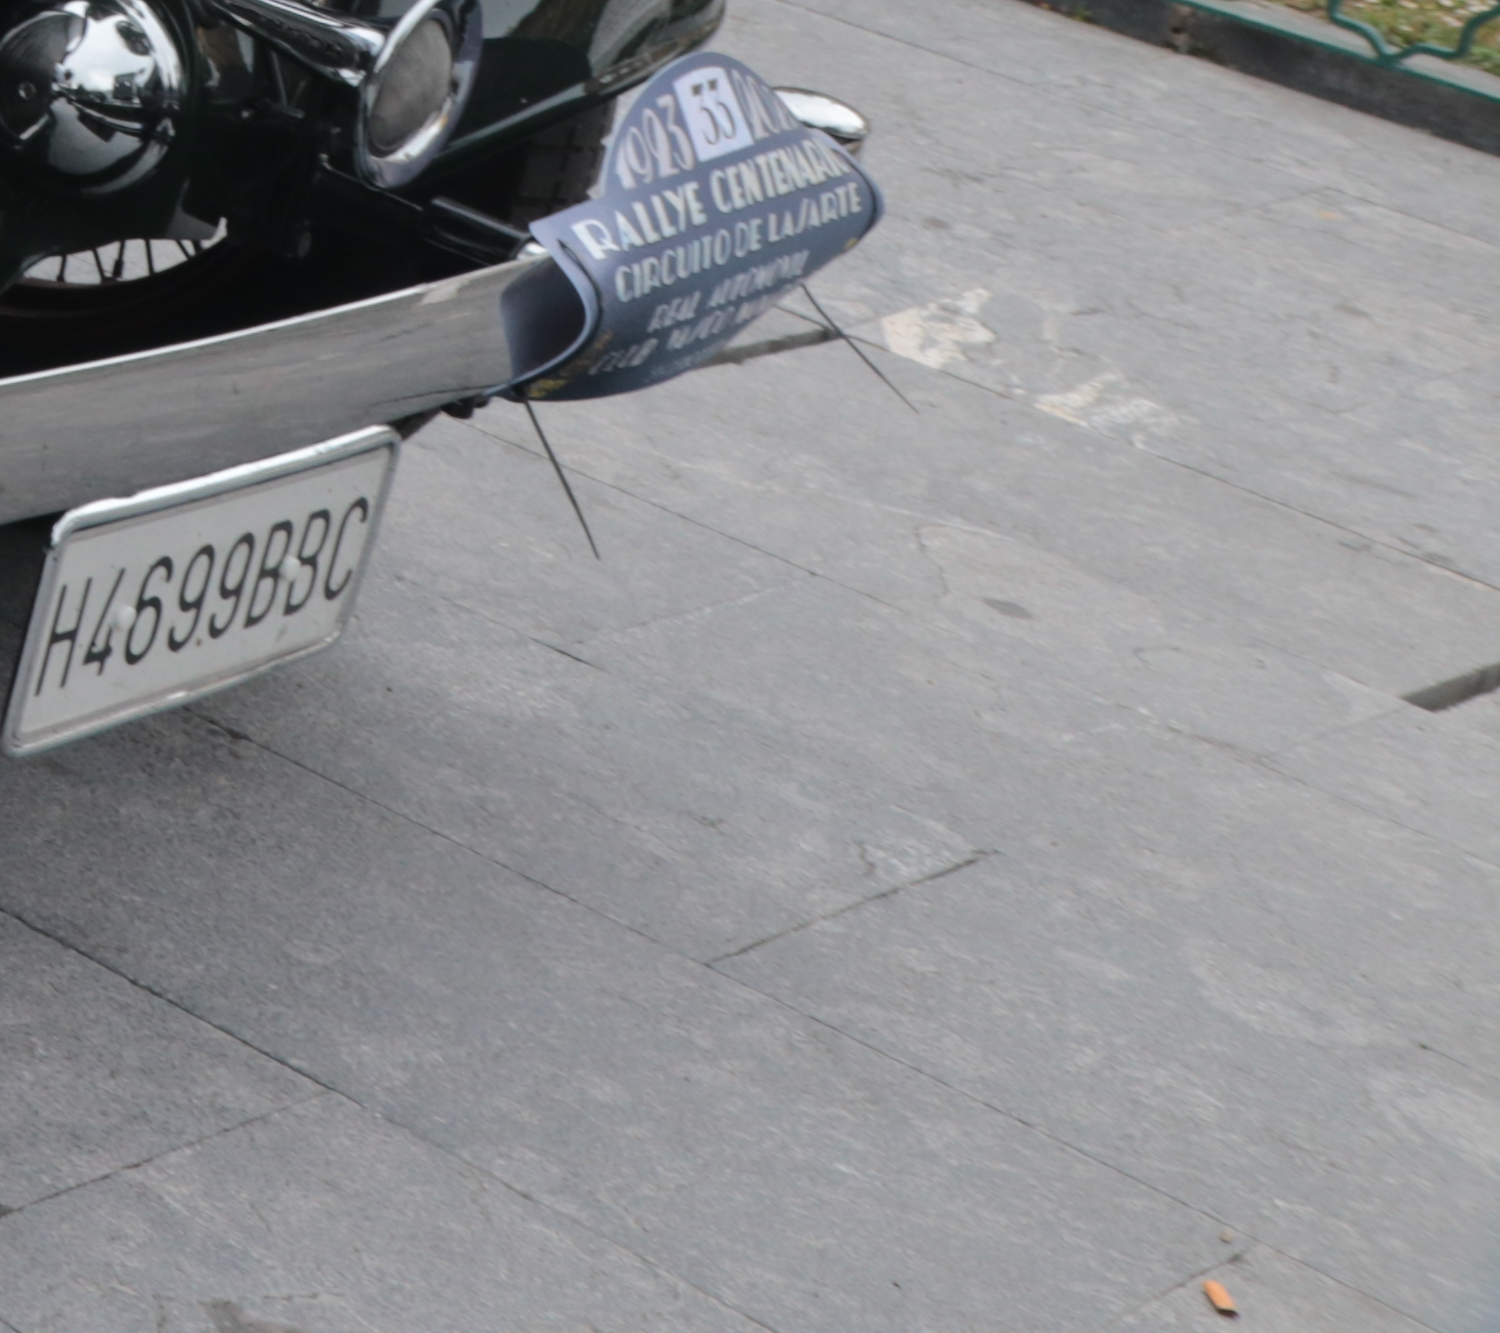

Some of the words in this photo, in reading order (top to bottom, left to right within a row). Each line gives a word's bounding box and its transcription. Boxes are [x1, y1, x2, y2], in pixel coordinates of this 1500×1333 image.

[615, 94, 697, 191] 1923
[690, 78, 736, 146] 33
[570, 180, 708, 261] RALLYE
[614, 229, 731, 303] CIRCUITO
[734, 218, 764, 258] DE
[768, 182, 863, 243] LASARTE
[35, 496, 369, 697] H4699BBC
